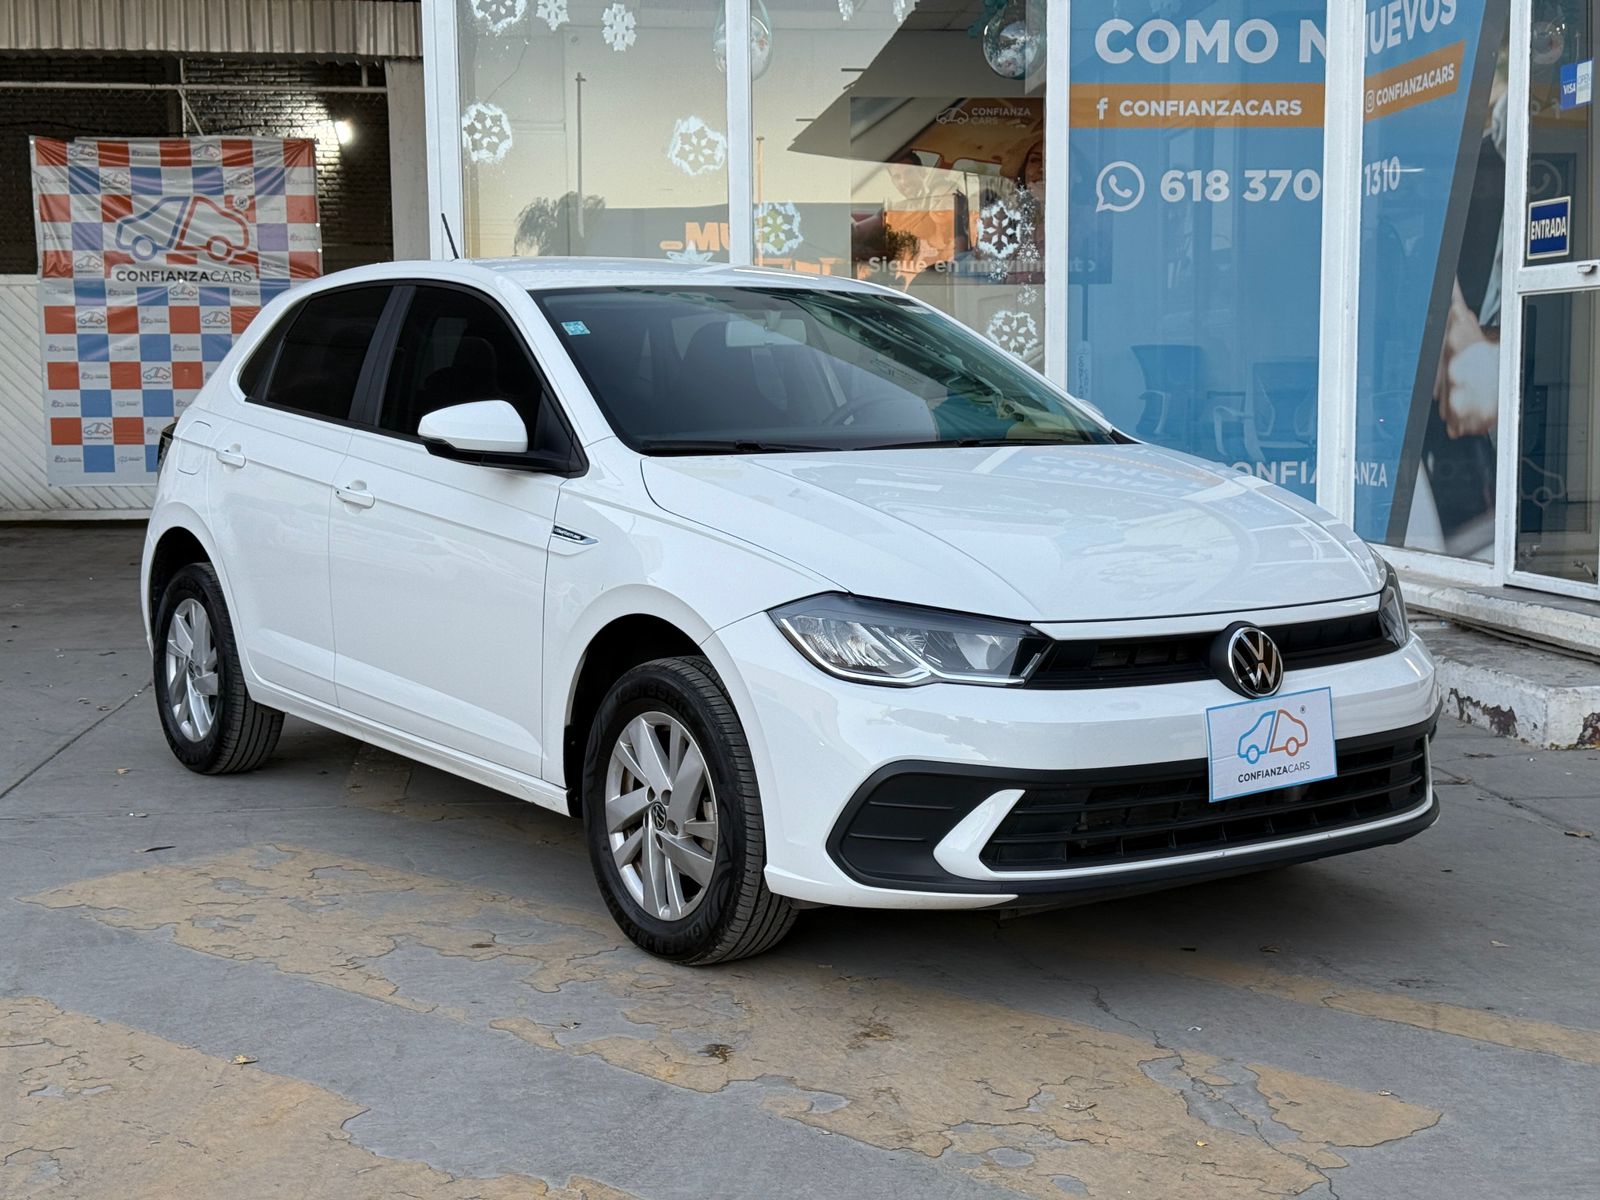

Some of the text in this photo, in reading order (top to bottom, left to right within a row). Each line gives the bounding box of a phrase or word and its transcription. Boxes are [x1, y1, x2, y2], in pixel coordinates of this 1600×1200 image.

[1095, 19, 1279, 64] COMO
[1376, 63, 1455, 107] CONFIANZACARS
[1562, 82, 1576, 95] VISA
[971, 107, 1031, 116] CONFIANZA
[1119, 100, 1302, 117] CONFIANZACARS
[1160, 156, 1401, 202] 618 370 1310
[1530, 216, 1567, 241] ENTRADA
[116, 270, 252, 283] CONFIANZACARS
[868, 256, 926, 277] Sigue
[935, 260, 960, 273] en
[1237, 761, 1311, 783] CONFIANZACARS
